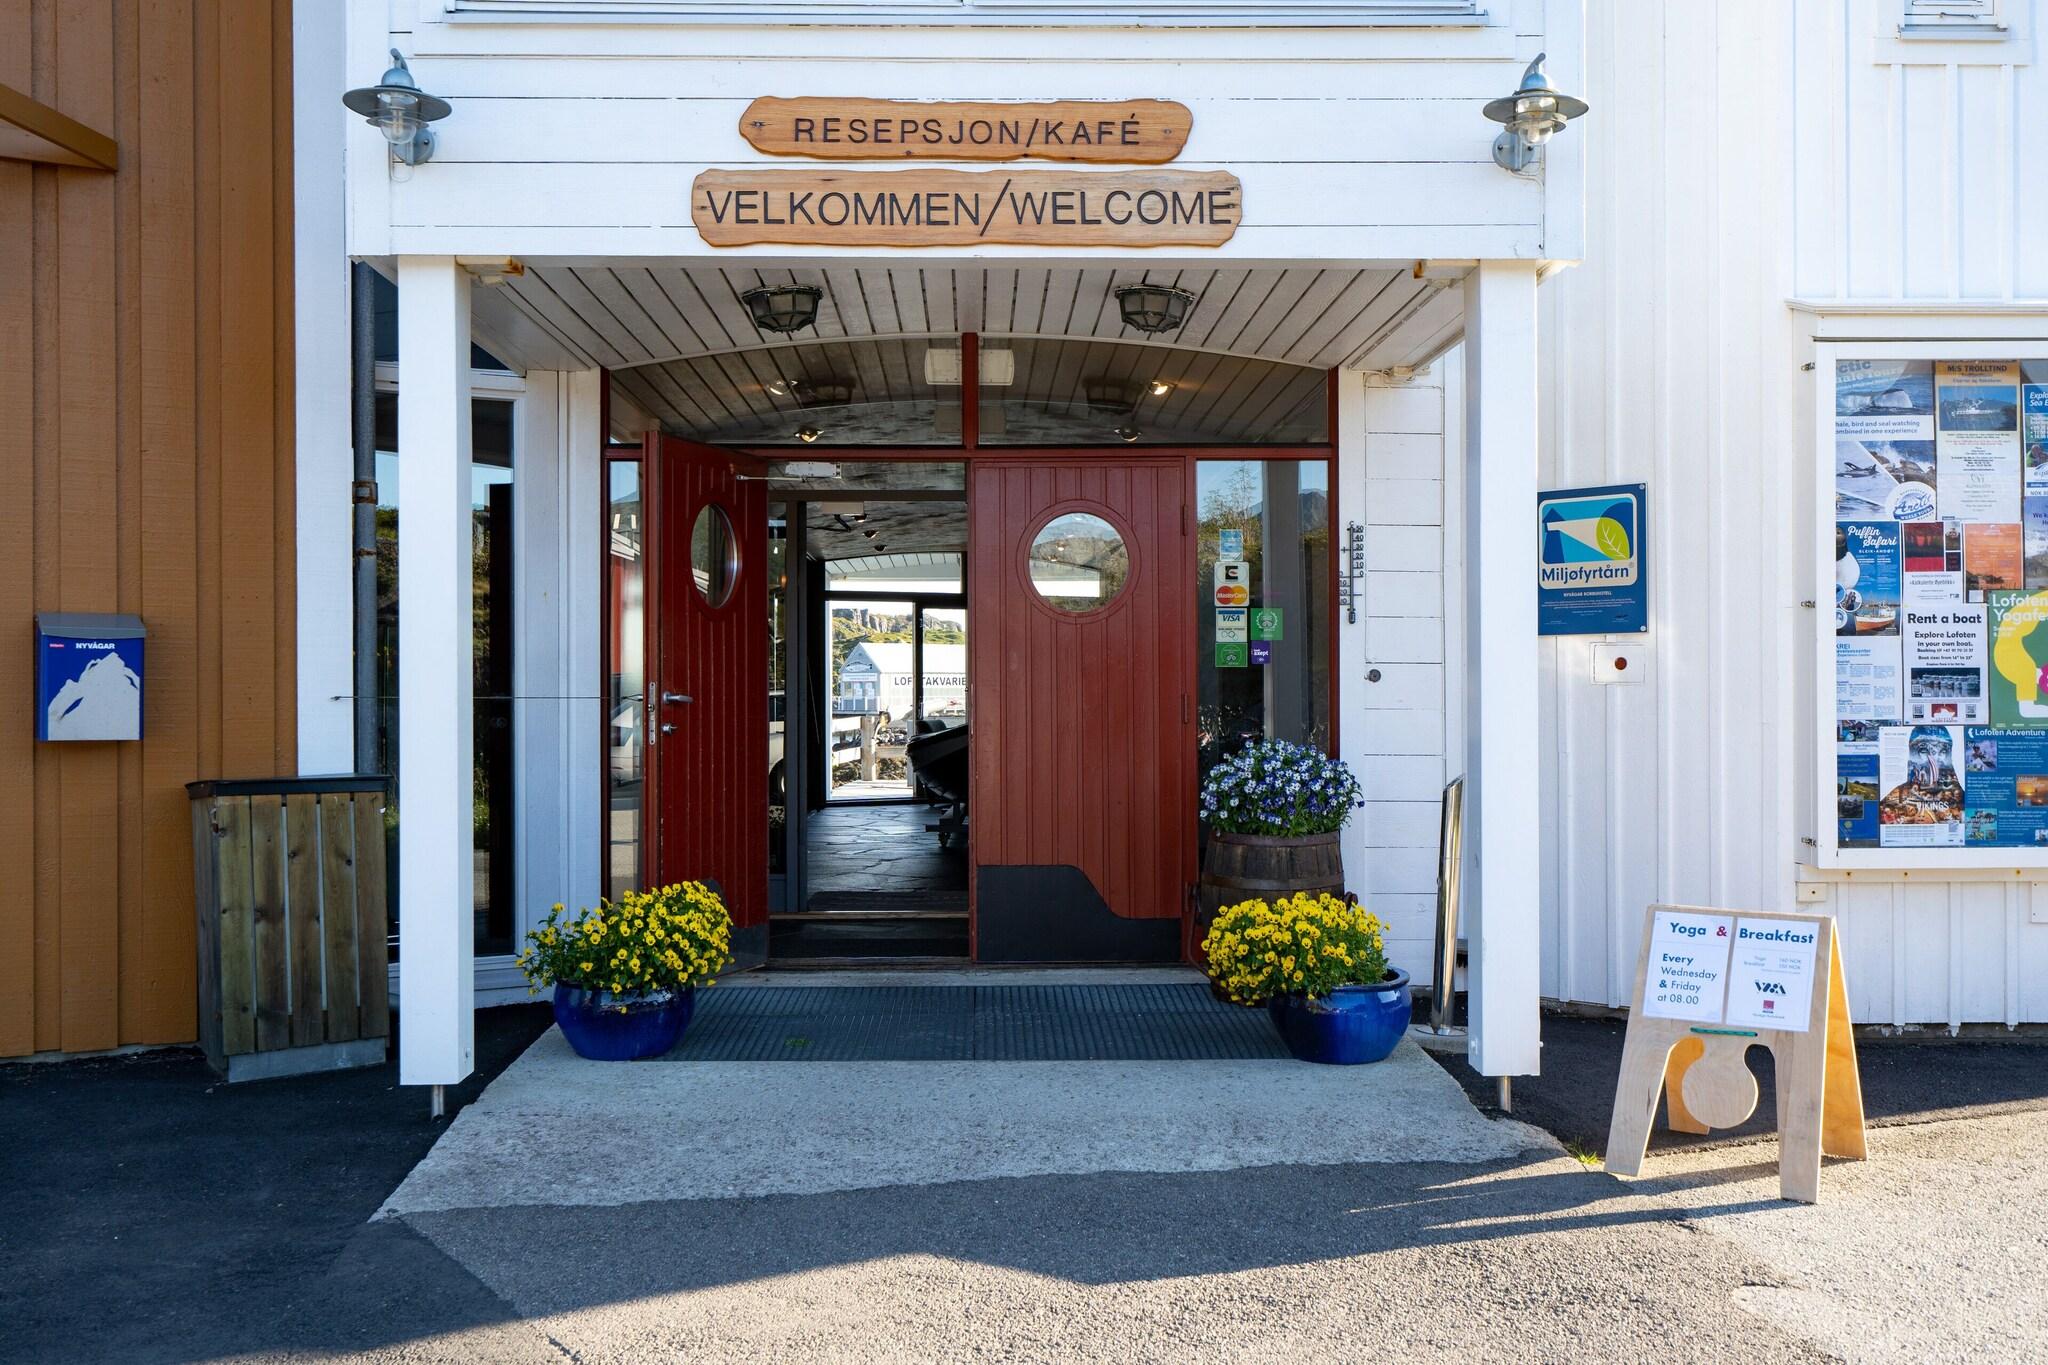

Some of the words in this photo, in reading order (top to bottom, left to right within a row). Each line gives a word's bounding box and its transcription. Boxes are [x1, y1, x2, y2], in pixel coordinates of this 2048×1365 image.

[794, 113, 1140, 147] RESEPSJON/KAFÉ
[707, 178, 1233, 237] VELKOMMEN/WELCOME
[1891, 420, 1920, 428] watching
[1847, 525, 1881, 539] Puffin
[1863, 536, 1898, 549] Safari
[1542, 564, 1629, 584] Miljøfyrtårn
[1992, 593, 2048, 607] Lofoten
[1222, 614, 1240, 622] VISA
[1907, 613, 1937, 624] Rent
[1941, 615, 1949, 624] a
[1952, 612, 1982, 624] boat
[1914, 631, 1944, 640] Explore
[1946, 631, 1976, 639] Lofoten
[75, 641, 115, 650] NYVÅGAR
[1975, 728, 2004, 736] Lofoten
[2006, 728, 2046, 736] Adventure
[1917, 801, 1949, 811] VIKINGS
[1670, 922, 1706, 937] Yoga
[1716, 926, 1727, 937] &
[1739, 928, 1814, 944] Breakfast
[1662, 953, 1694, 966] Every
[1660, 966, 1718, 981] Wednesday
[1659, 979, 1667, 989] &
[1670, 980, 1701, 993] Friday
[1657, 993, 1667, 1002] at
[1669, 994, 1699, 1005] 08.00
